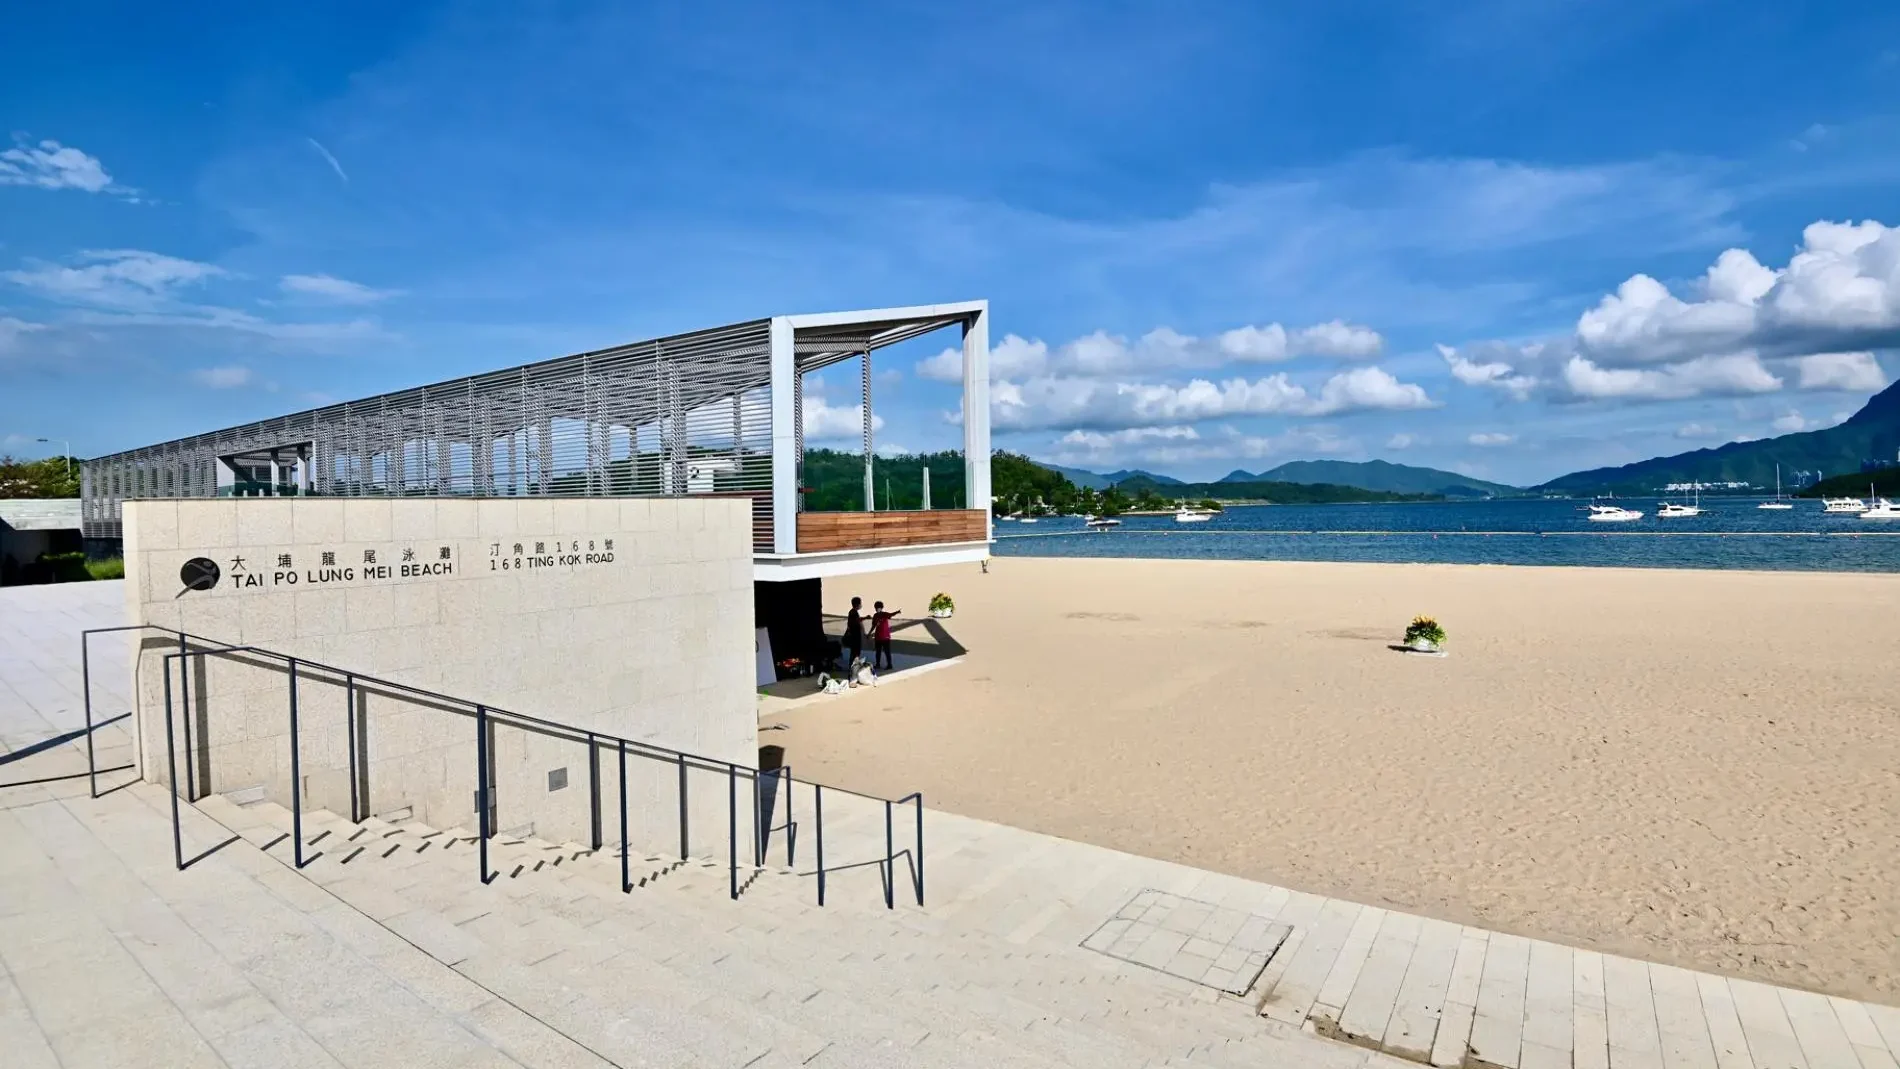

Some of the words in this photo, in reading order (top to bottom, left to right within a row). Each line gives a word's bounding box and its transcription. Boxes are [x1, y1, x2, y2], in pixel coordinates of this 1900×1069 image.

[230, 546, 451, 571] 大埔龍尾泳灘
[527, 556, 554, 568] TING
[559, 554, 581, 565] KOK
[586, 552, 614, 563] ROAD
[231, 573, 264, 588] TAI
[274, 571, 298, 586] PO
[307, 568, 354, 583] LUNG
[364, 565, 392, 579] MEI
[401, 562, 452, 577] BEACH
